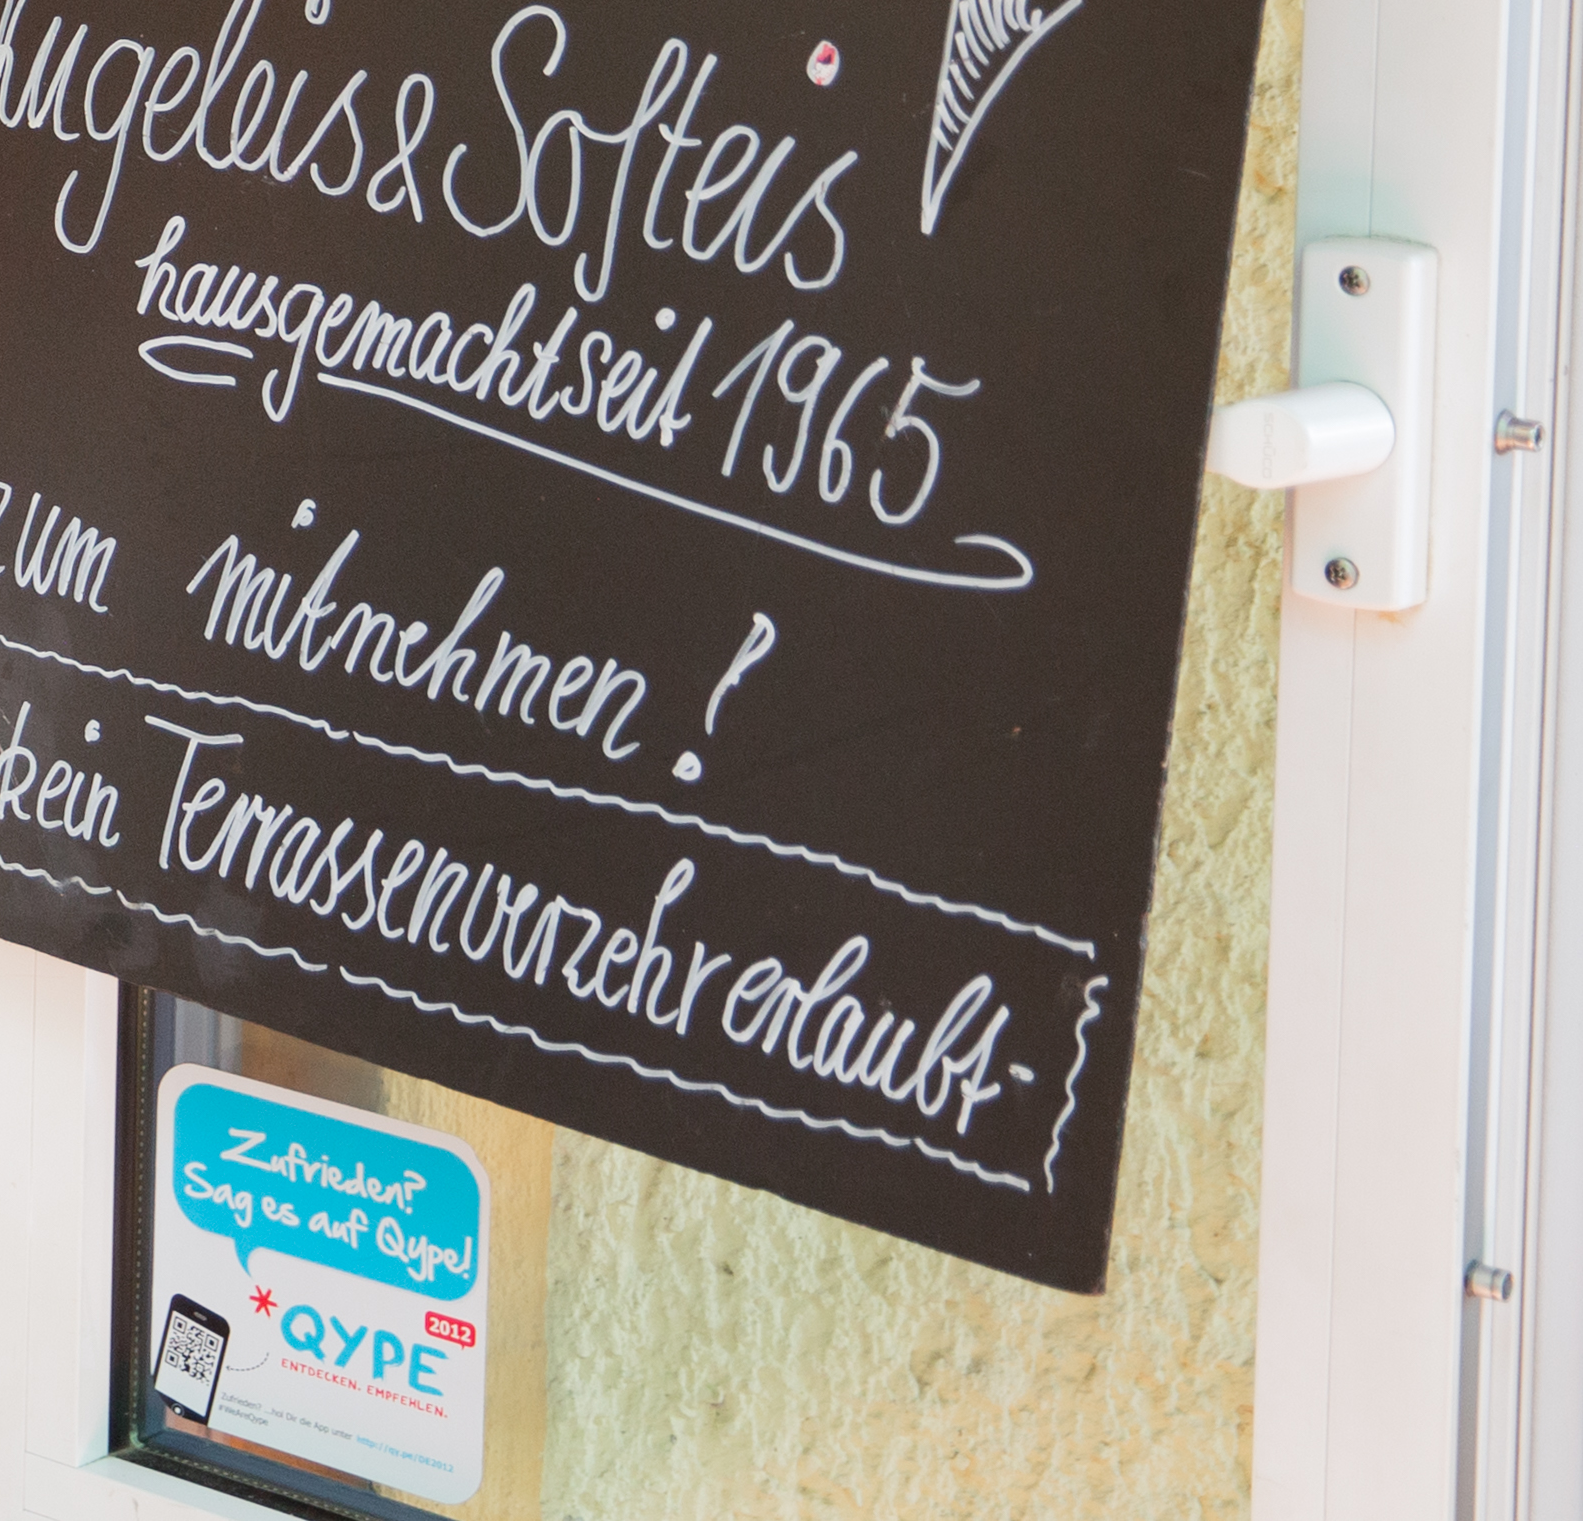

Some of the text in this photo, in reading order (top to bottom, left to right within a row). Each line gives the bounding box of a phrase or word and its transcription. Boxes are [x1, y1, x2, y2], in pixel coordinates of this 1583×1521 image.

[712, 318, 983, 525] 1965
[220, 1127, 427, 1214] Zufrieden?
[183, 1161, 474, 1282] Sag es auf Qype!
[279, 1303, 451, 1398] QYPE
[428, 1316, 473, 1344] 2012
[281, 1357, 449, 1419] ENTDECKEN. EMPFEHLEN.
[313, 1421, 330, 1435] App
